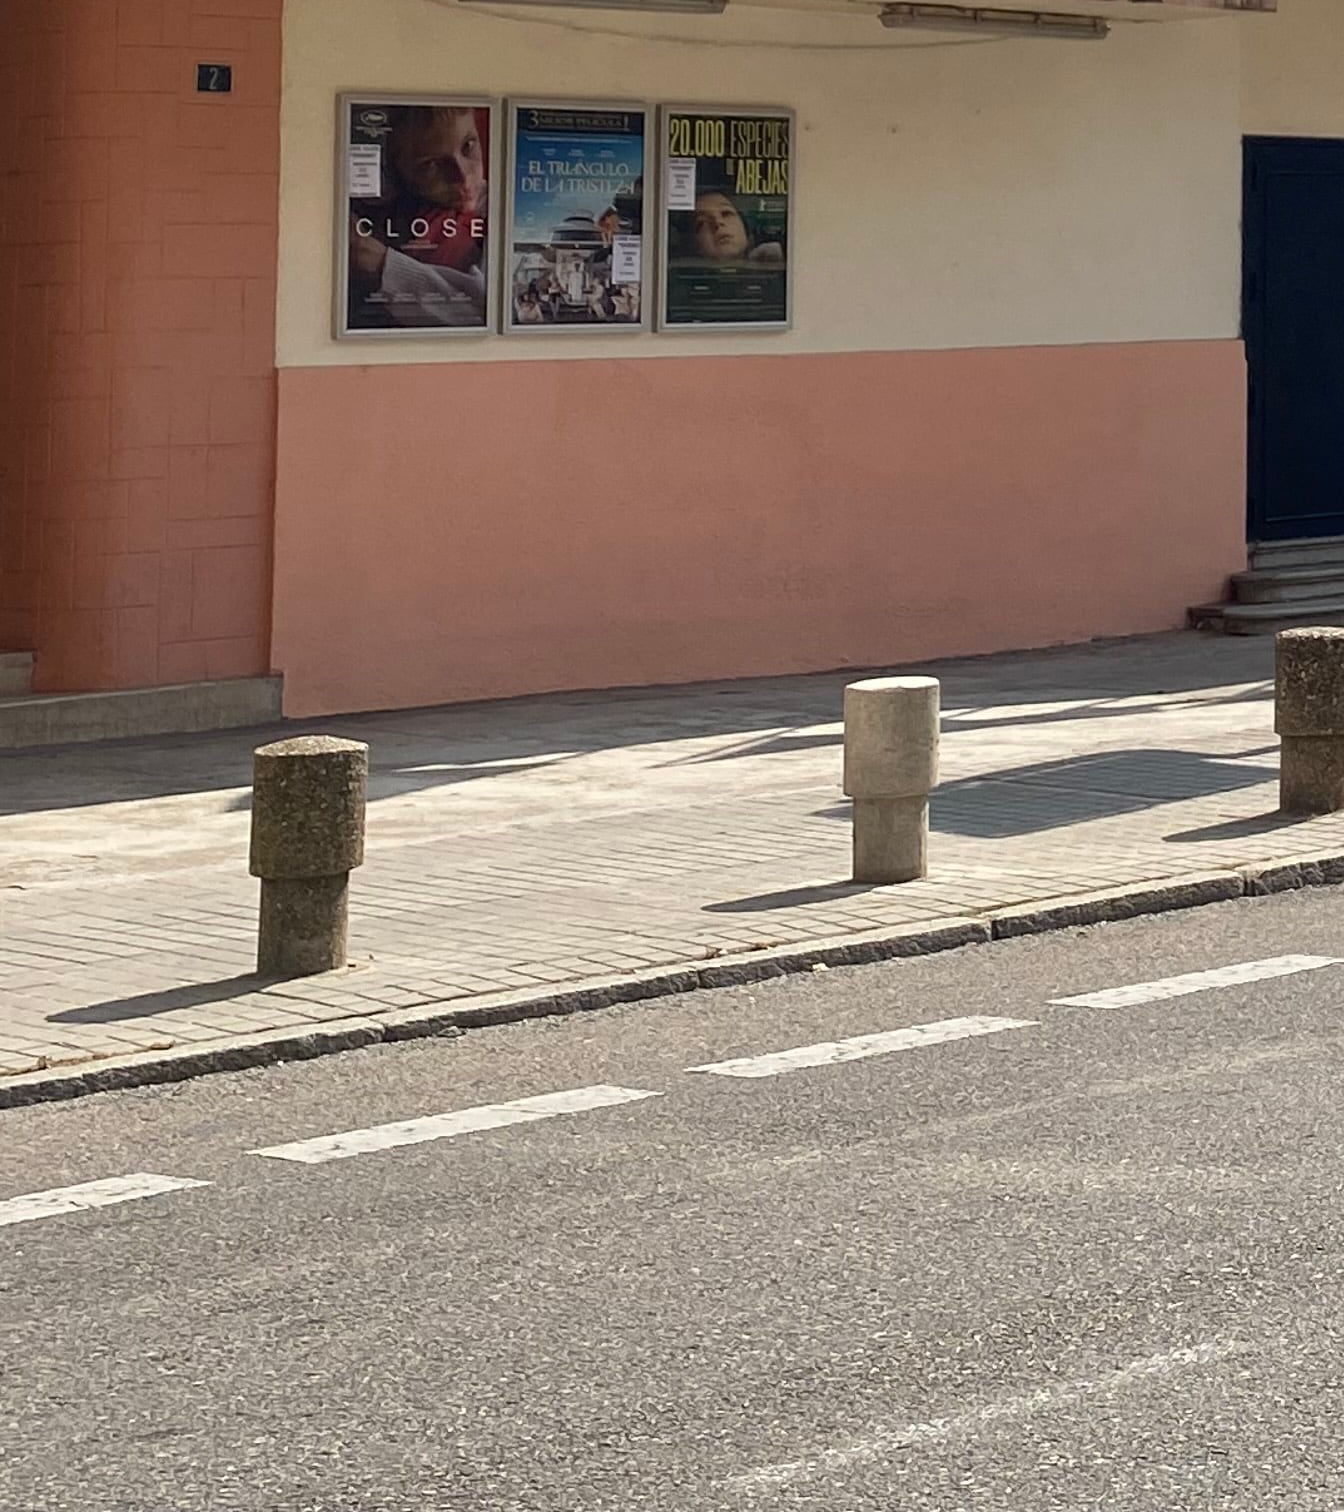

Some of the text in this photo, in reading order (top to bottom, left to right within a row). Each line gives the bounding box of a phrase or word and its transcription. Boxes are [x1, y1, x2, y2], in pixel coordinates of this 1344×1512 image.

[208, 67, 218, 90] 2
[670, 119, 788, 158] 20.000 ESPECIES
[528, 160, 545, 175] EL
[736, 159, 788, 194] ABEJAS
[521, 177, 635, 194] DE LA TRISTEZA
[356, 218, 485, 238] CLOSE
